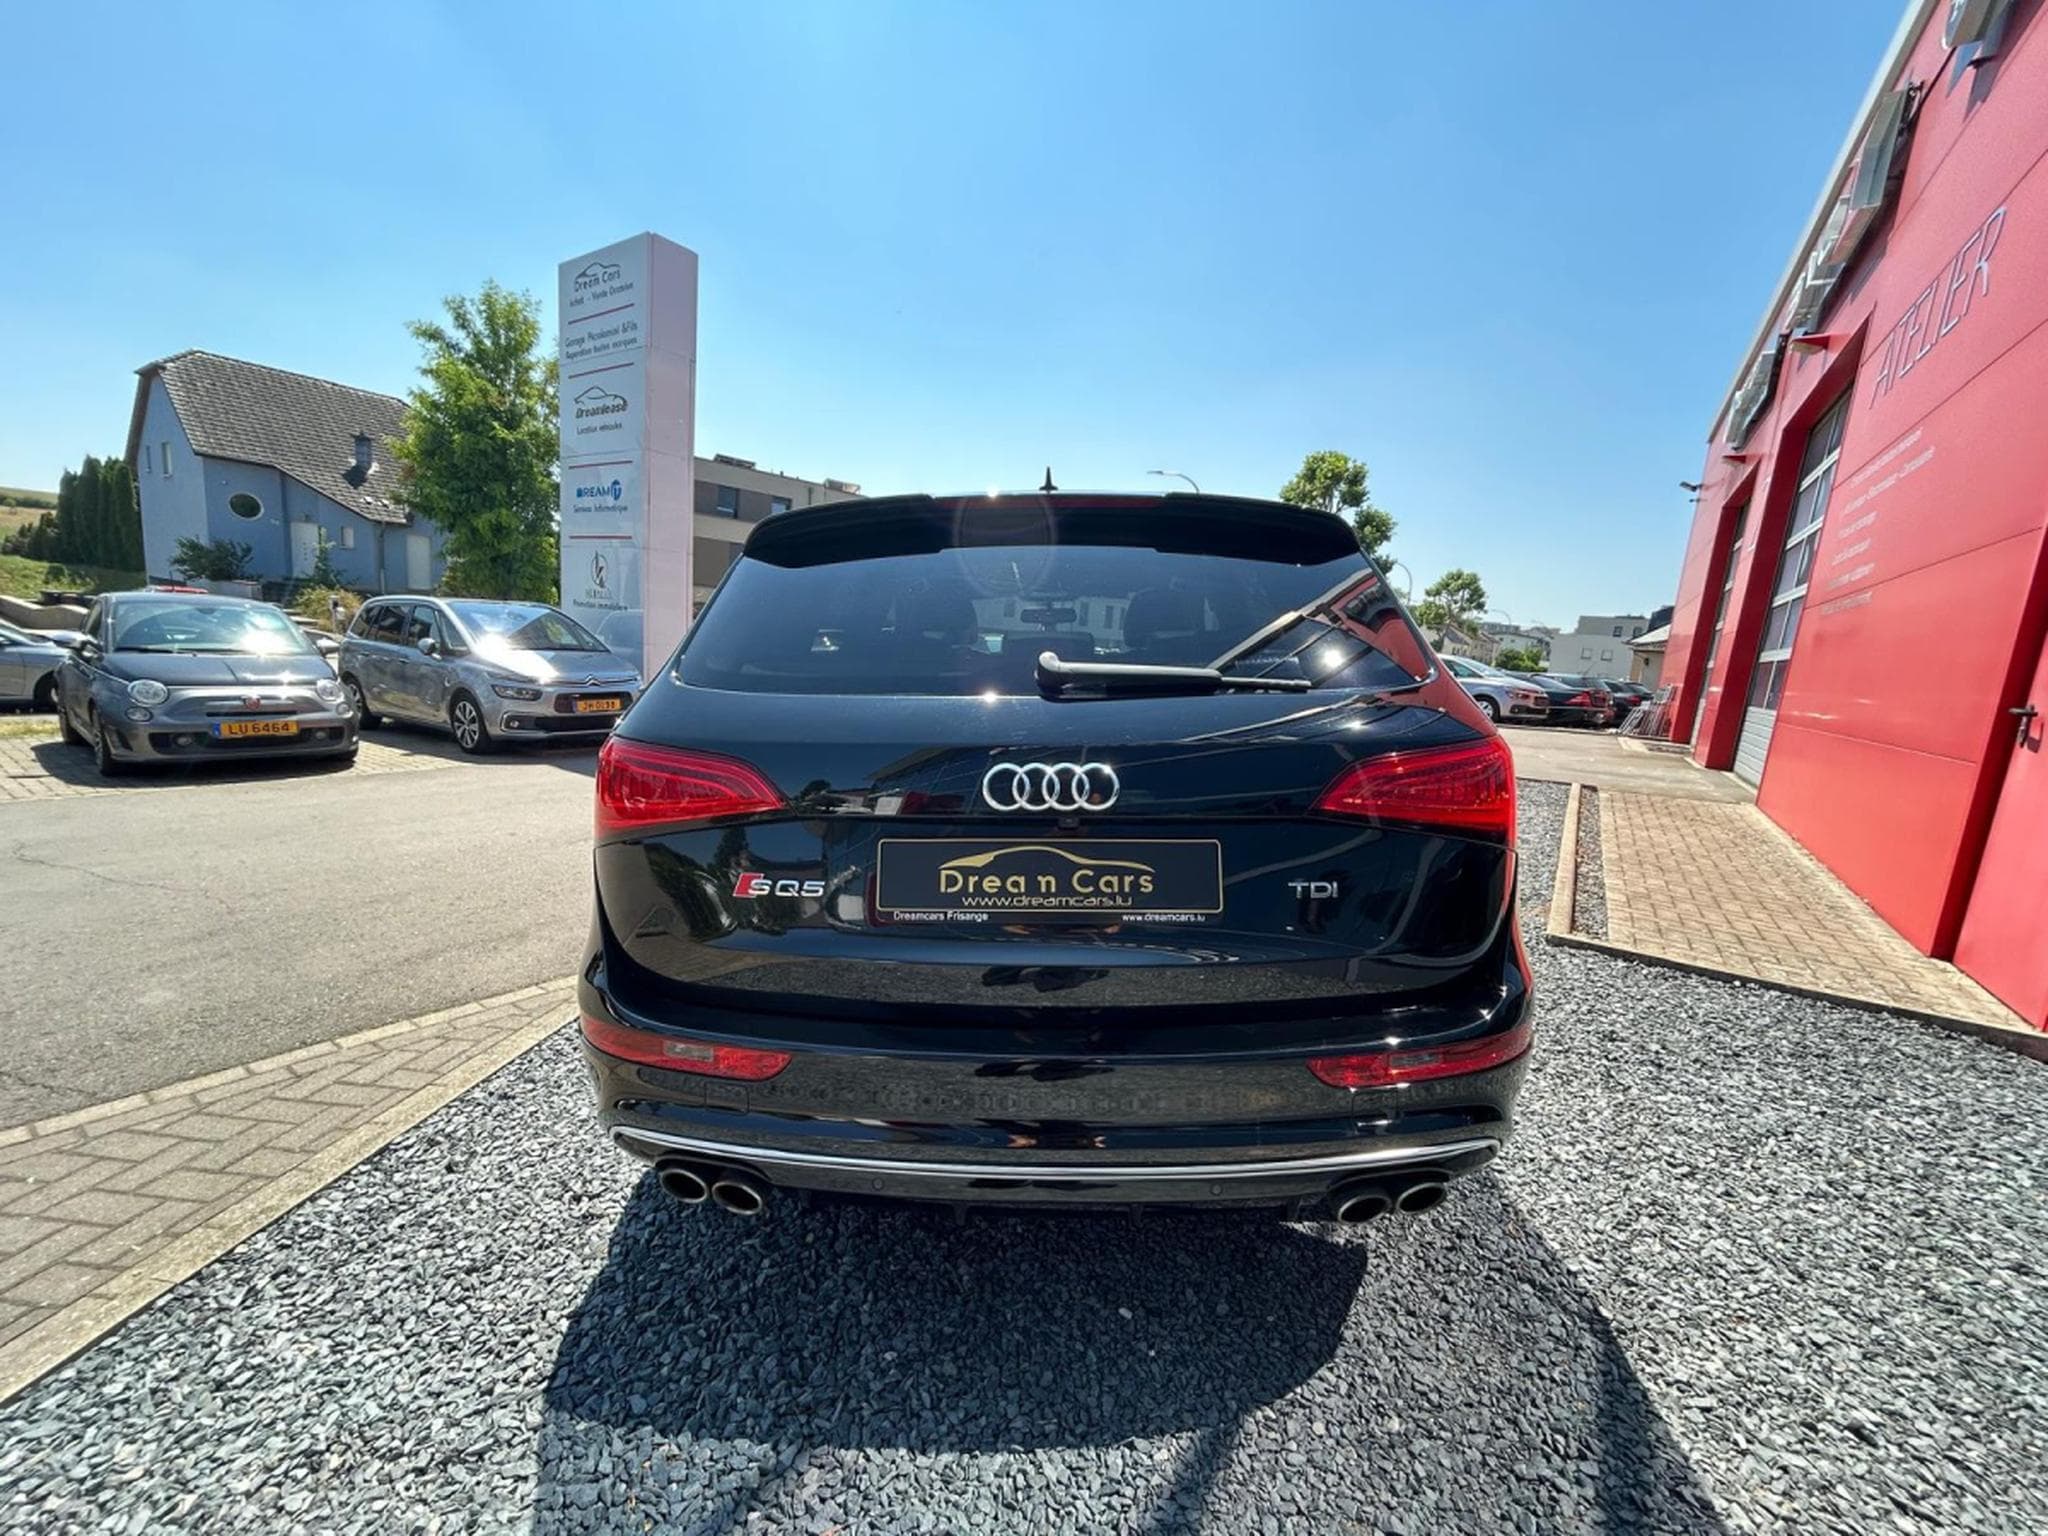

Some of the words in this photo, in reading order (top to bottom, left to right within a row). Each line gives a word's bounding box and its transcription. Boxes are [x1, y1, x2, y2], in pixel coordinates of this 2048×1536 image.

[1869, 207, 2007, 410] ATELIER
[228, 724, 249, 735] LU
[252, 722, 289, 733] 6464
[744, 878, 825, 897] SQ5
[1072, 869, 1153, 893] Cars
[1288, 881, 1338, 898] TDI
[962, 895, 1132, 907] www.dreamcars.lu
[893, 910, 945, 921] Dreamcars
[946, 909, 989, 922] Frisange
[1122, 913, 1205, 922] www.dreamcars.lu
